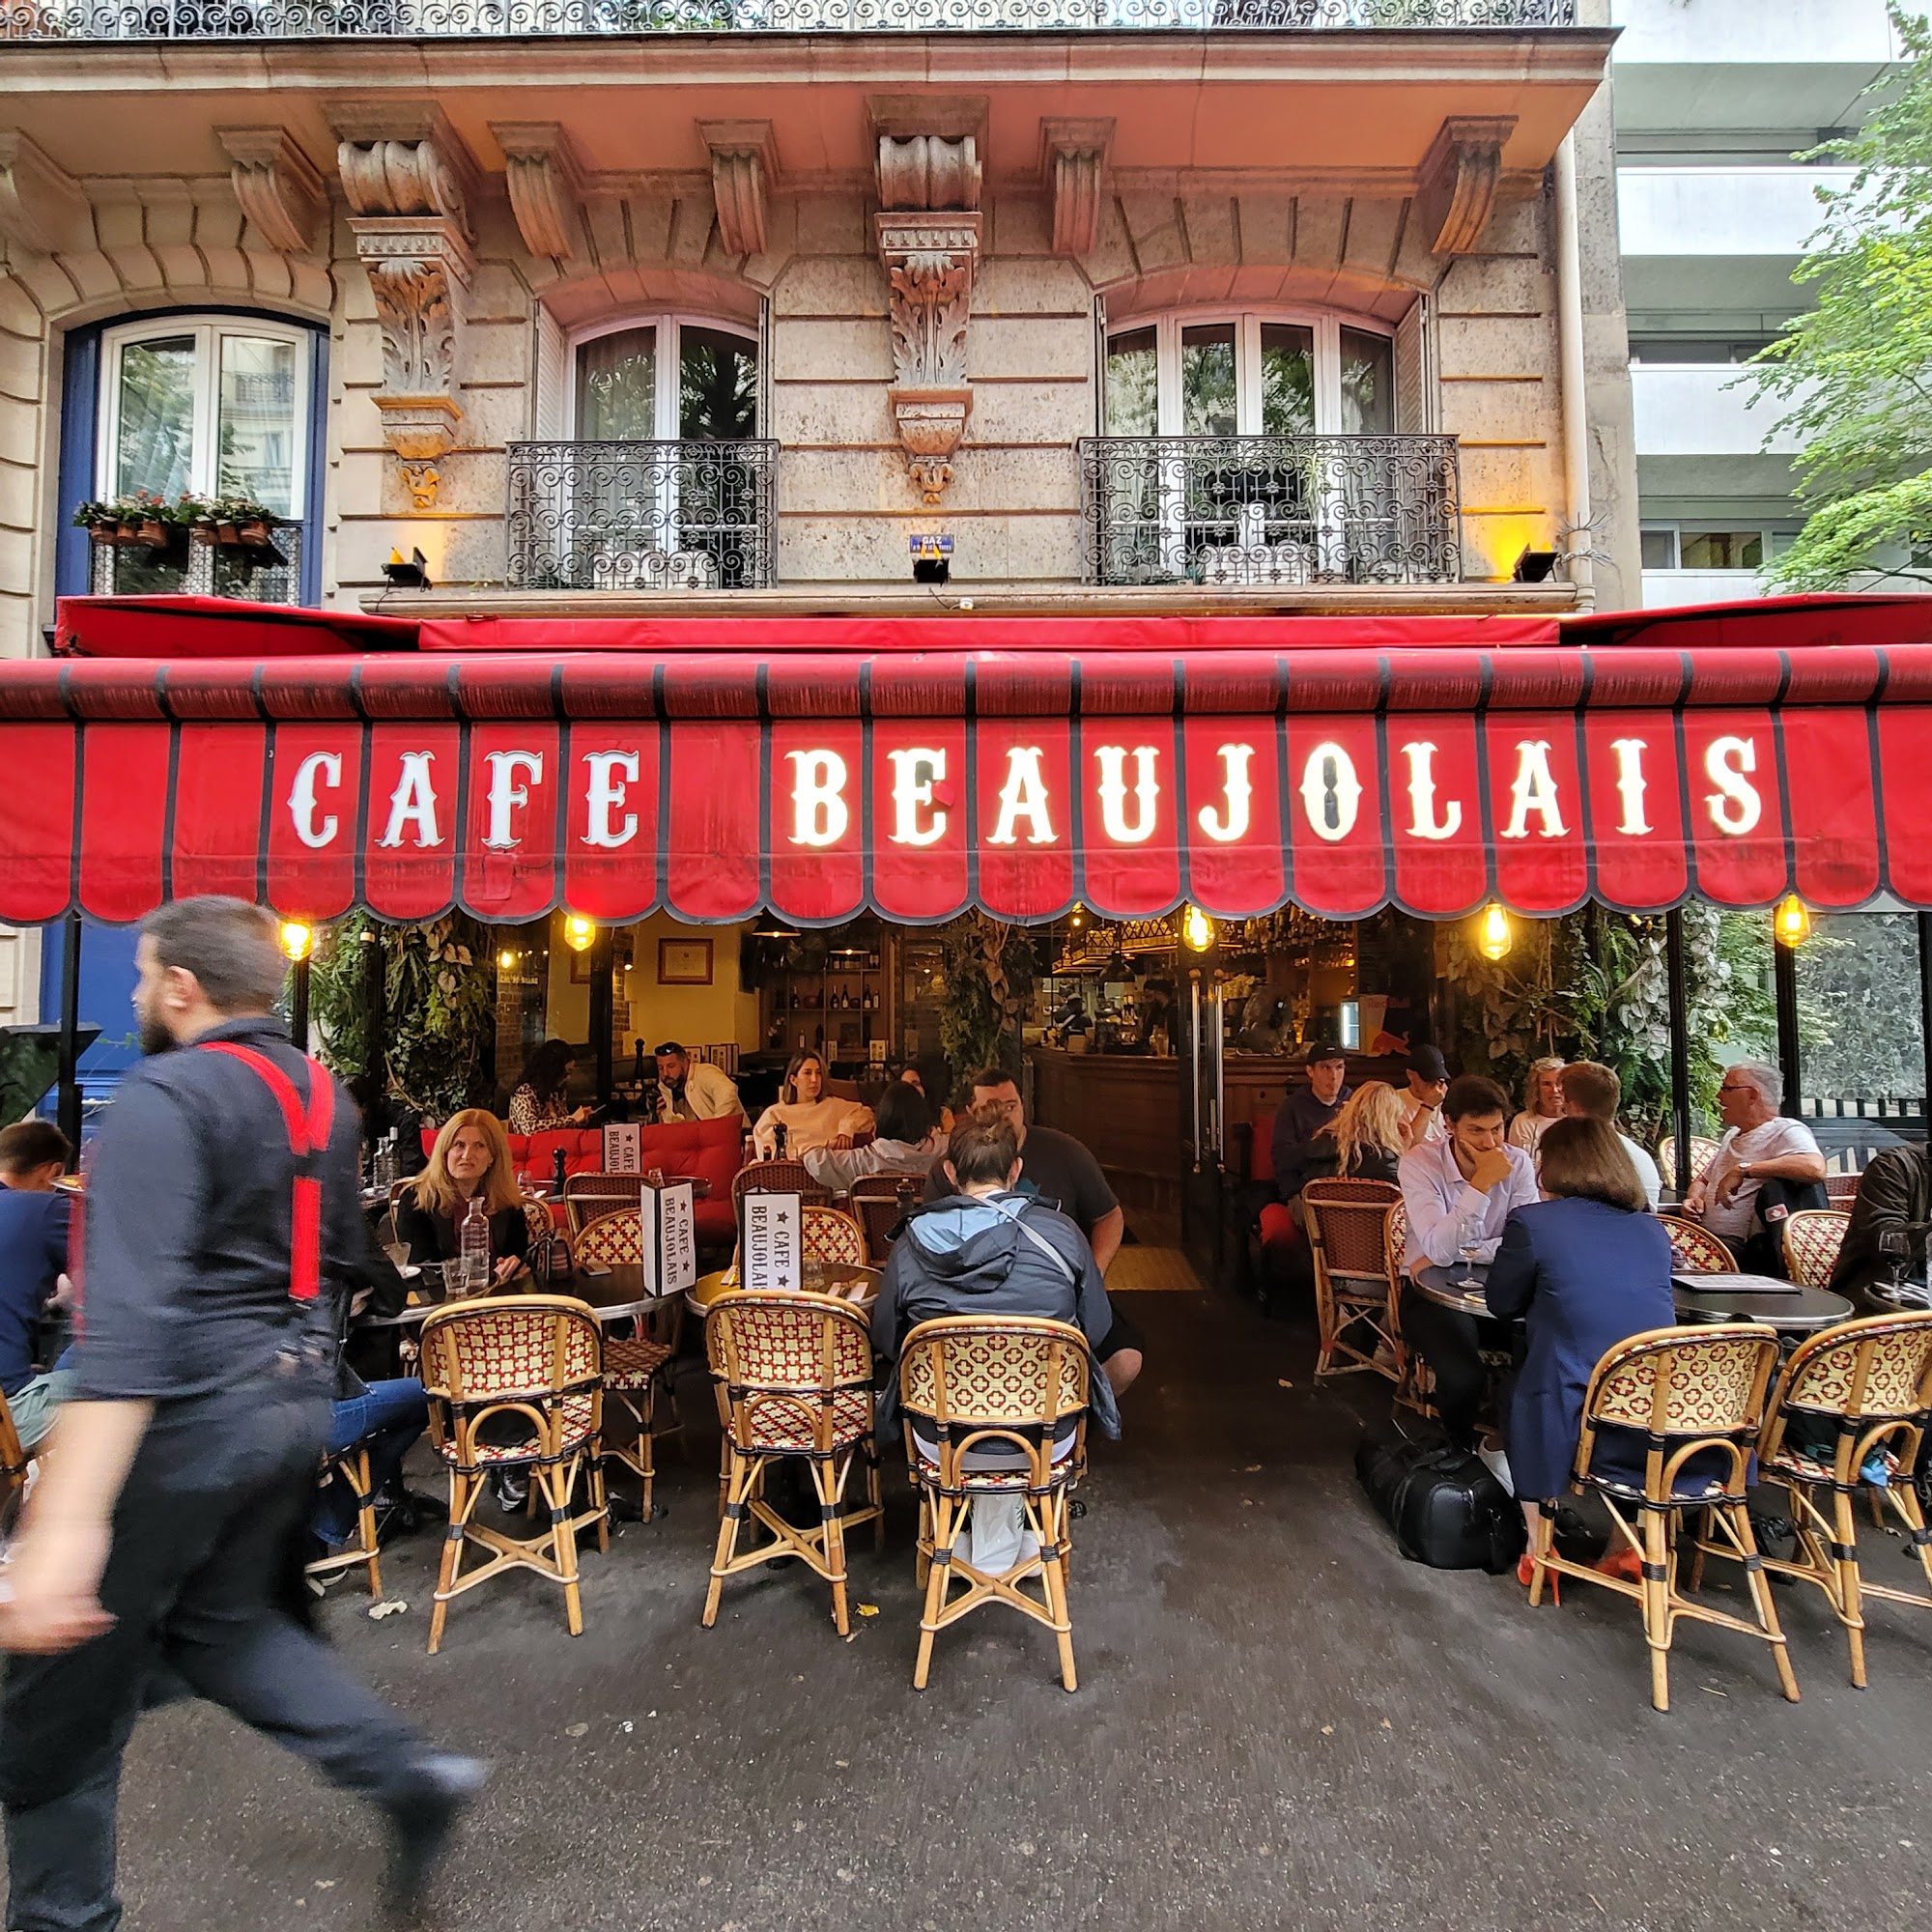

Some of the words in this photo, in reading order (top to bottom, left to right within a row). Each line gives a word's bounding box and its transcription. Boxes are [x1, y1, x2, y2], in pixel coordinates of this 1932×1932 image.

[287, 750, 639, 849] CAFE
[783, 735, 1762, 847] BEAUJOLAIS
[609, 1131, 620, 1174] BEAUJOL
[623, 1147, 634, 1171] CAFE
[665, 1197, 678, 1285] BEAUJOLAIS
[678, 1218, 690, 1255] CAFE
[751, 1206, 768, 1290] BEAUJOLAI
[774, 1231, 790, 1267] CAFE
